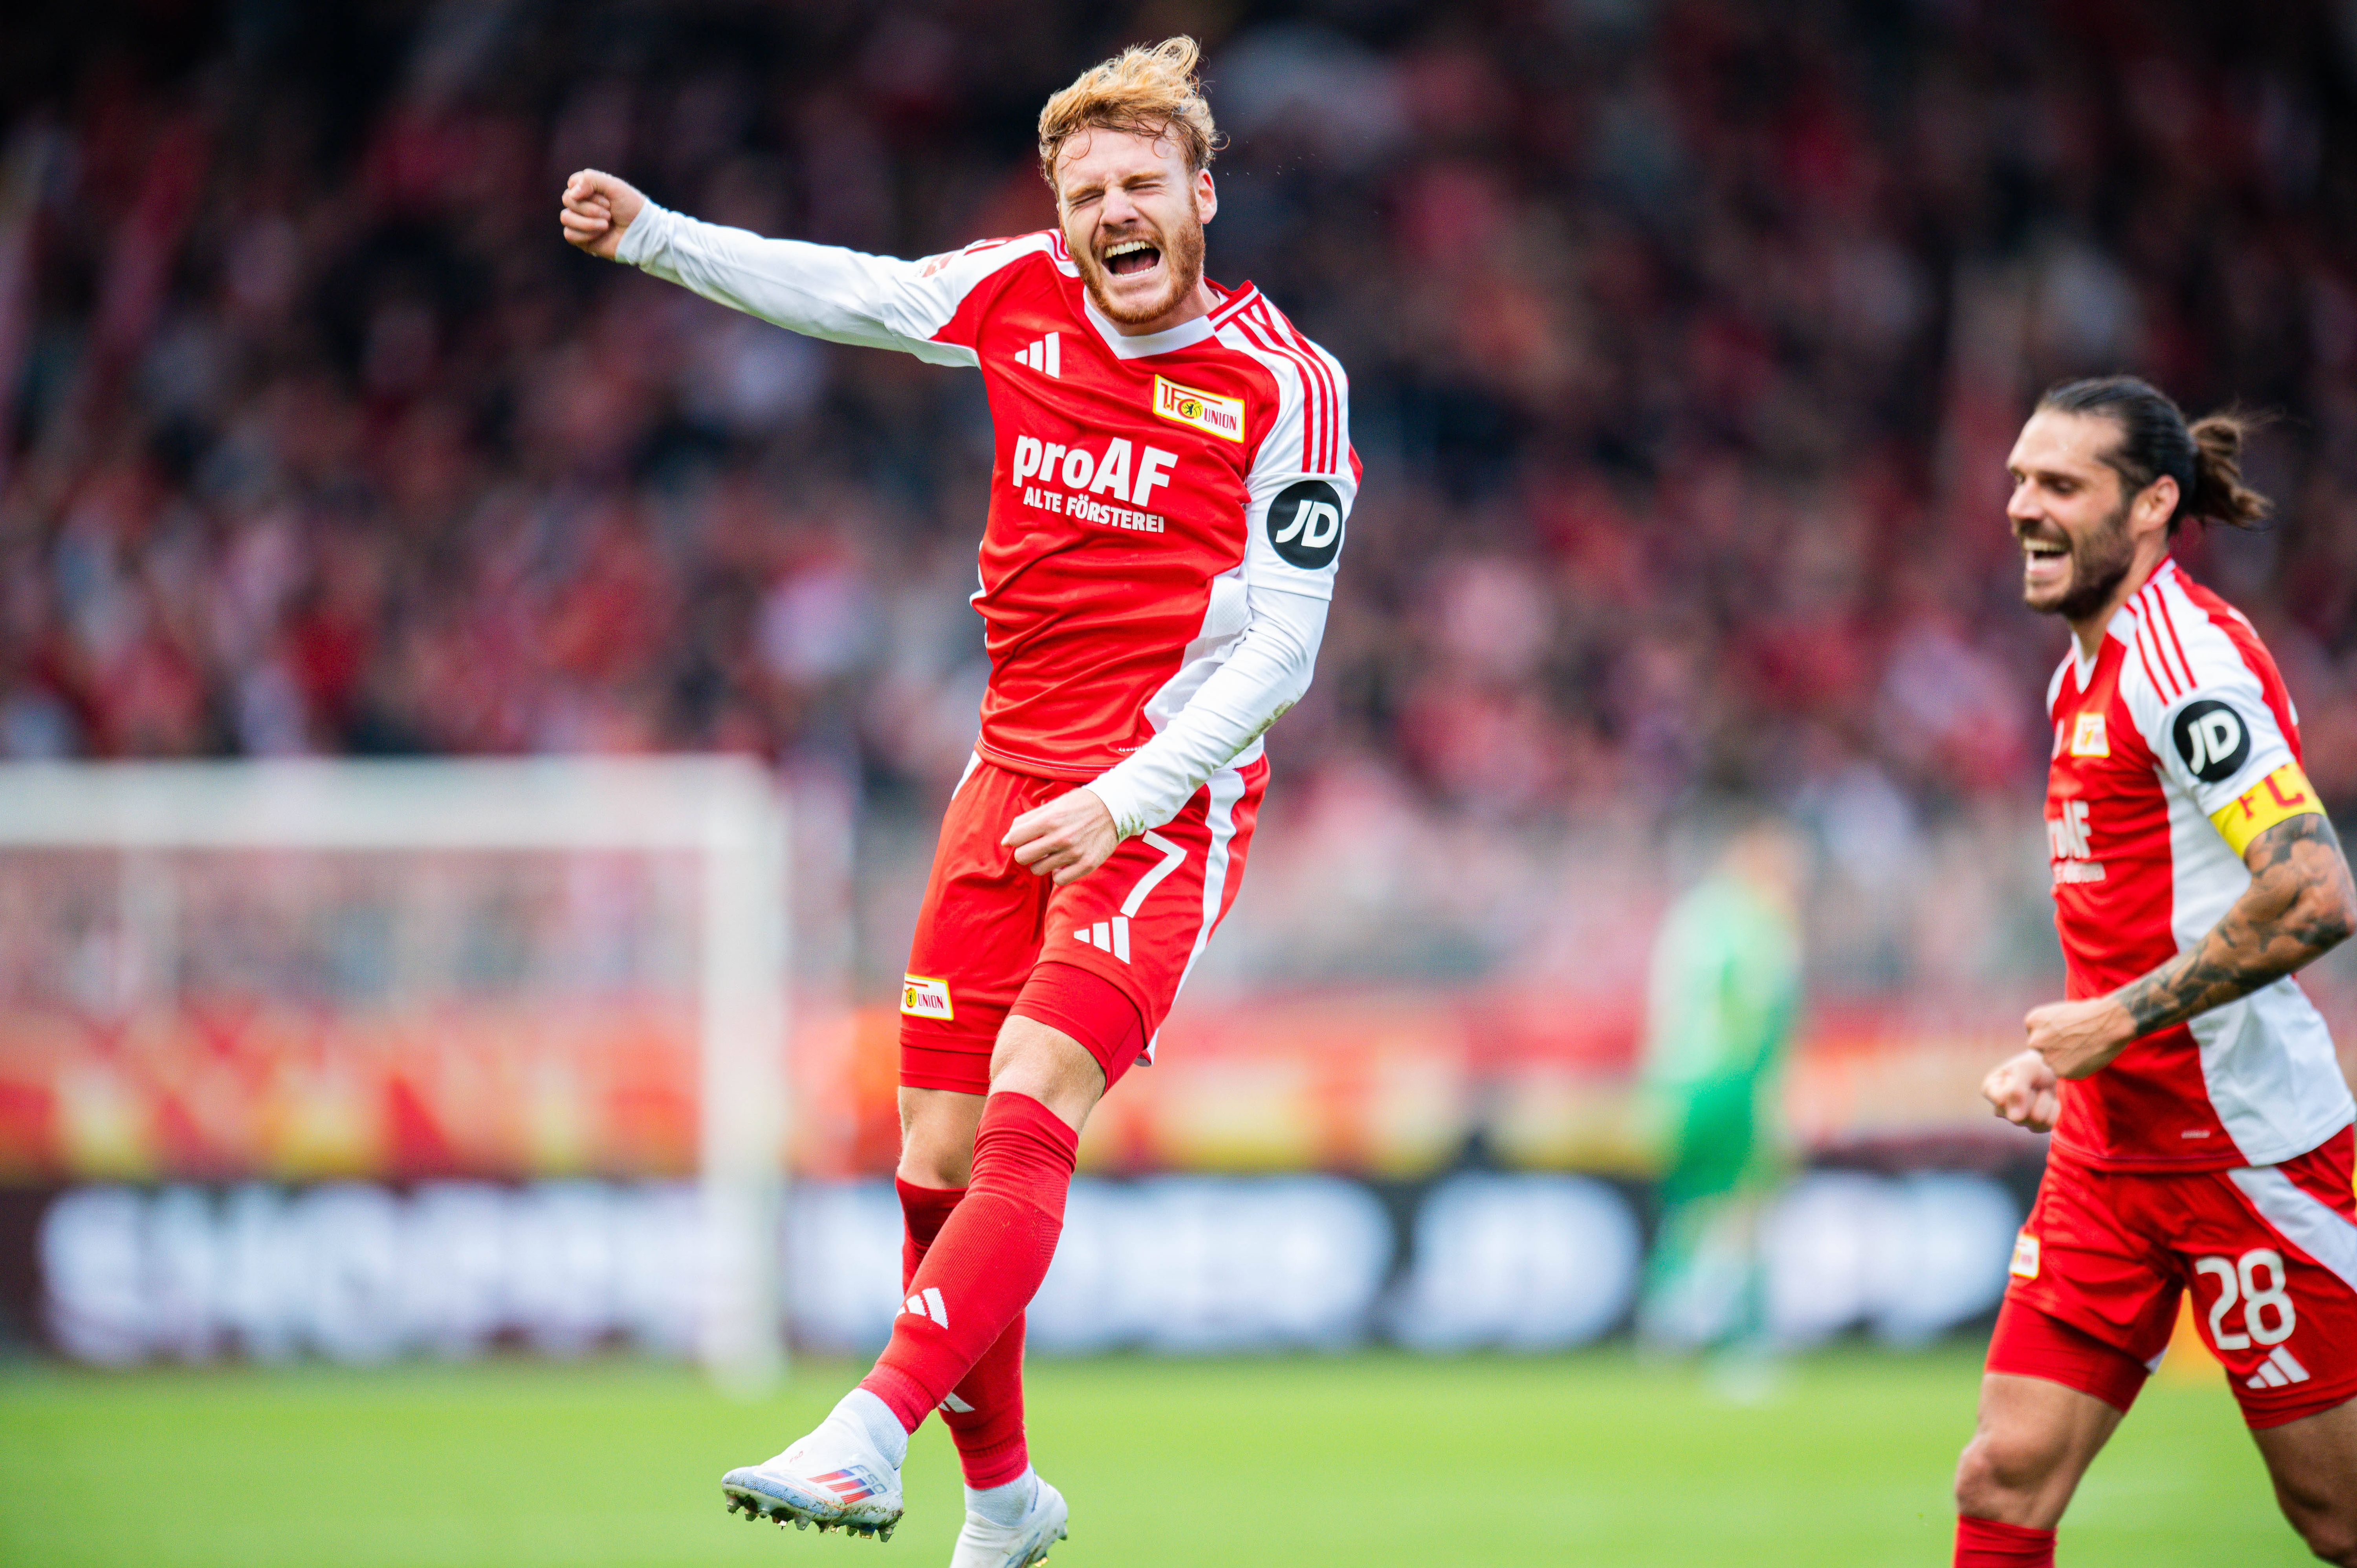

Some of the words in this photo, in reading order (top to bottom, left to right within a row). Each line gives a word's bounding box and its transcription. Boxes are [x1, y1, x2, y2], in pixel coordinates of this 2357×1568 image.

[1204, 407, 1237, 431] UNION
[1013, 435, 1178, 507] proAF
[1023, 487, 1062, 513] ALTE
[1066, 493, 1164, 533] FÖRSTEREI
[1276, 499, 1339, 548] JD
[2188, 709, 2241, 775] JD
[1120, 830, 1188, 918] 7
[917, 993, 944, 1009] UNION
[2195, 1247, 2296, 1350] 28
